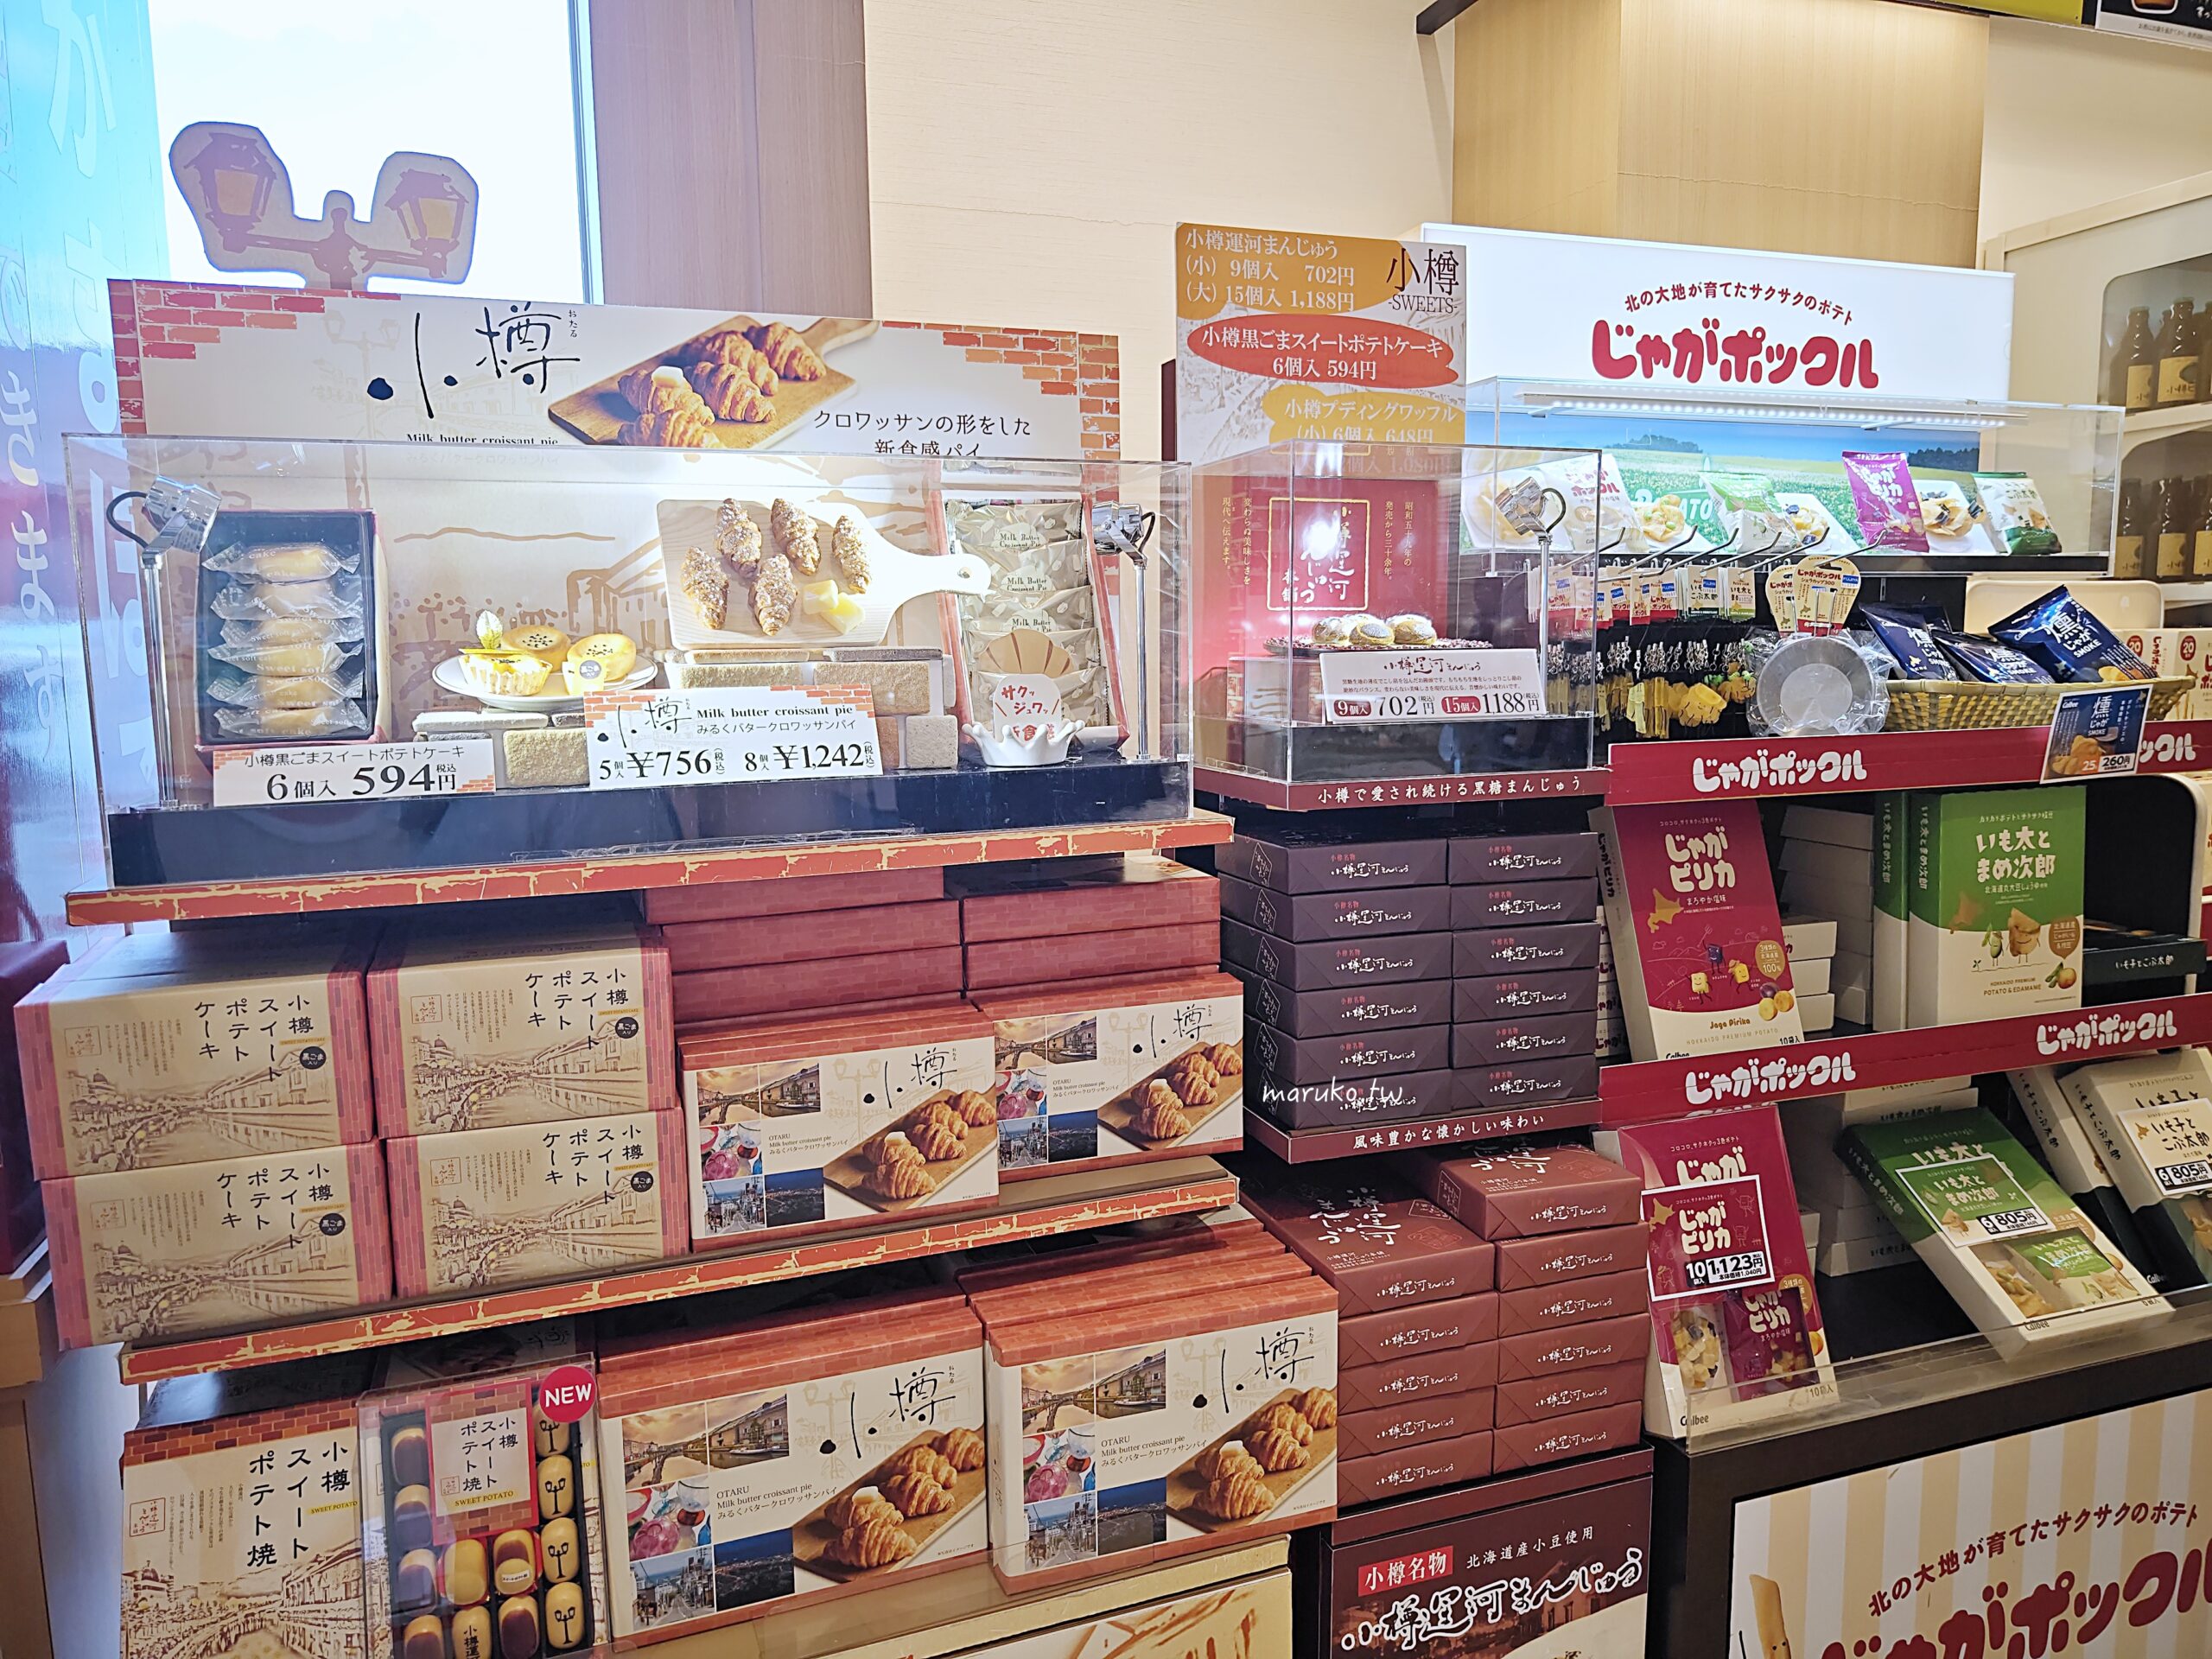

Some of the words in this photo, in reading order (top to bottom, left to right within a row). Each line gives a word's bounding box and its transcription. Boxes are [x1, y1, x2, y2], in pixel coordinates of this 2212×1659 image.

[1185, 229, 1338, 259] 小樽運河まんじゅう
[1230, 258, 1280, 282] 9個入
[1304, 264, 1355, 286] 702円
[1386, 247, 1460, 296] 小樽
[1225, 284, 1282, 308] 15個入
[1624, 281, 1853, 327] 北の大地が育てたサクサクのポテト
[567, 309, 577, 339] おたる
[1201, 326, 1444, 359] 小樽黒ごまスイートポテトケーキ
[1592, 318, 1879, 389] じゃがポックル
[1272, 357, 1320, 378] 6個入
[1327, 358, 1376, 380] 594円
[814, 410, 1031, 437] クロワッサンの形をした
[1284, 399, 1459, 423] 小樽プディングワッフル
[2073, 639, 2102, 658] SMOKE
[696, 709, 724, 718] Milk
[731, 707, 769, 717] butter
[775, 706, 829, 716] croissant
[836, 707, 853, 718] pie
[696, 719, 856, 735] みるくバタークロワッサンパイ
[2089, 718, 2109, 728] じゃが
[245, 746, 465, 767] 小樽黒ごまスイートポテトケーキ
[1693, 749, 1867, 792] じゃがポックル
[267, 774, 337, 801] 6個入
[353, 764, 456, 797] 594円
[1318, 775, 1581, 804] 小樽で愛され続ける黒糖まんじゅう
[1665, 826, 1728, 862] じゃが
[1976, 826, 2050, 853] いも太と
[1669, 860, 1736, 893] ピリカ
[1977, 854, 2056, 882] まめ次郎
[525, 973, 546, 1027] ケーキ
[552, 970, 572, 1030] ポテト
[607, 968, 629, 1005] 小樽
[288, 995, 314, 1033] 小樽
[580, 971, 600, 1050] スイート
[1709, 1020, 1727, 1030] Jaga
[1728, 1018, 1751, 1028] Pirika
[194, 1001, 219, 1059] ケーキ
[226, 998, 250, 1062] ポテト
[258, 997, 283, 1082] スイート
[2037, 1009, 2177, 1055] じゃがポックル
[1686, 1052, 1856, 1104] じゃがポックル
[621, 1124, 644, 1160] 小樽
[1353, 1116, 1545, 1149] 風味豊かな懐かしい味わい
[2151, 1117, 2196, 1135] いも子と
[2161, 1131, 2209, 1151] こぶ太郎
[542, 1132, 563, 1185] ケーキ
[569, 1128, 589, 1187] ポテト
[596, 1128, 615, 1205] スイート
[1676, 1146, 1747, 1185] じゃが
[247, 1167, 270, 1230] ポテト
[308, 1163, 334, 1201] 小樽
[1934, 1173, 1986, 1192] いも太と
[1945, 1186, 2000, 1206] まめ次郎
[217, 1173, 241, 1229] ケーキ
[278, 1167, 302, 1249] スイート
[1679, 1201, 1726, 1231] じゃが
[1681, 1227, 1731, 1255] ピリカ
[1749, 1306, 1791, 1333] ピリカ
[544, 1383, 592, 1408] NEW
[499, 1417, 518, 1448] 小樽
[1101, 1435, 1130, 1447] OTARU
[1101, 1448, 1116, 1458] Milk
[1119, 1445, 1141, 1455] butter
[1141, 1440, 1172, 1452] croissant
[1173, 1435, 1185, 1446] pie
[321, 1441, 351, 1493] 小樽
[461, 1421, 482, 1492] ポテト焼
[481, 1420, 497, 1488] スイート
[247, 1450, 277, 1567] ポテト焼
[287, 1448, 311, 1560] スイート
[311, 1505, 332, 1515] SWEET
[333, 1500, 358, 1511] POTATO
[454, 1496, 481, 1507] SWEET
[484, 1490, 514, 1503] POTATO
[716, 1485, 750, 1499] OTARU
[717, 1498, 734, 1510] Milk
[737, 1493, 762, 1507] butter
[764, 1487, 798, 1502] croissant
[799, 1483, 812, 1496] pie
[1466, 1525, 1594, 1570] 北海道産小豆使用
[1868, 1501, 2198, 1618] 北の大地が育てたサクサクのポテト
[1364, 1551, 1447, 1591] 小樽名物
